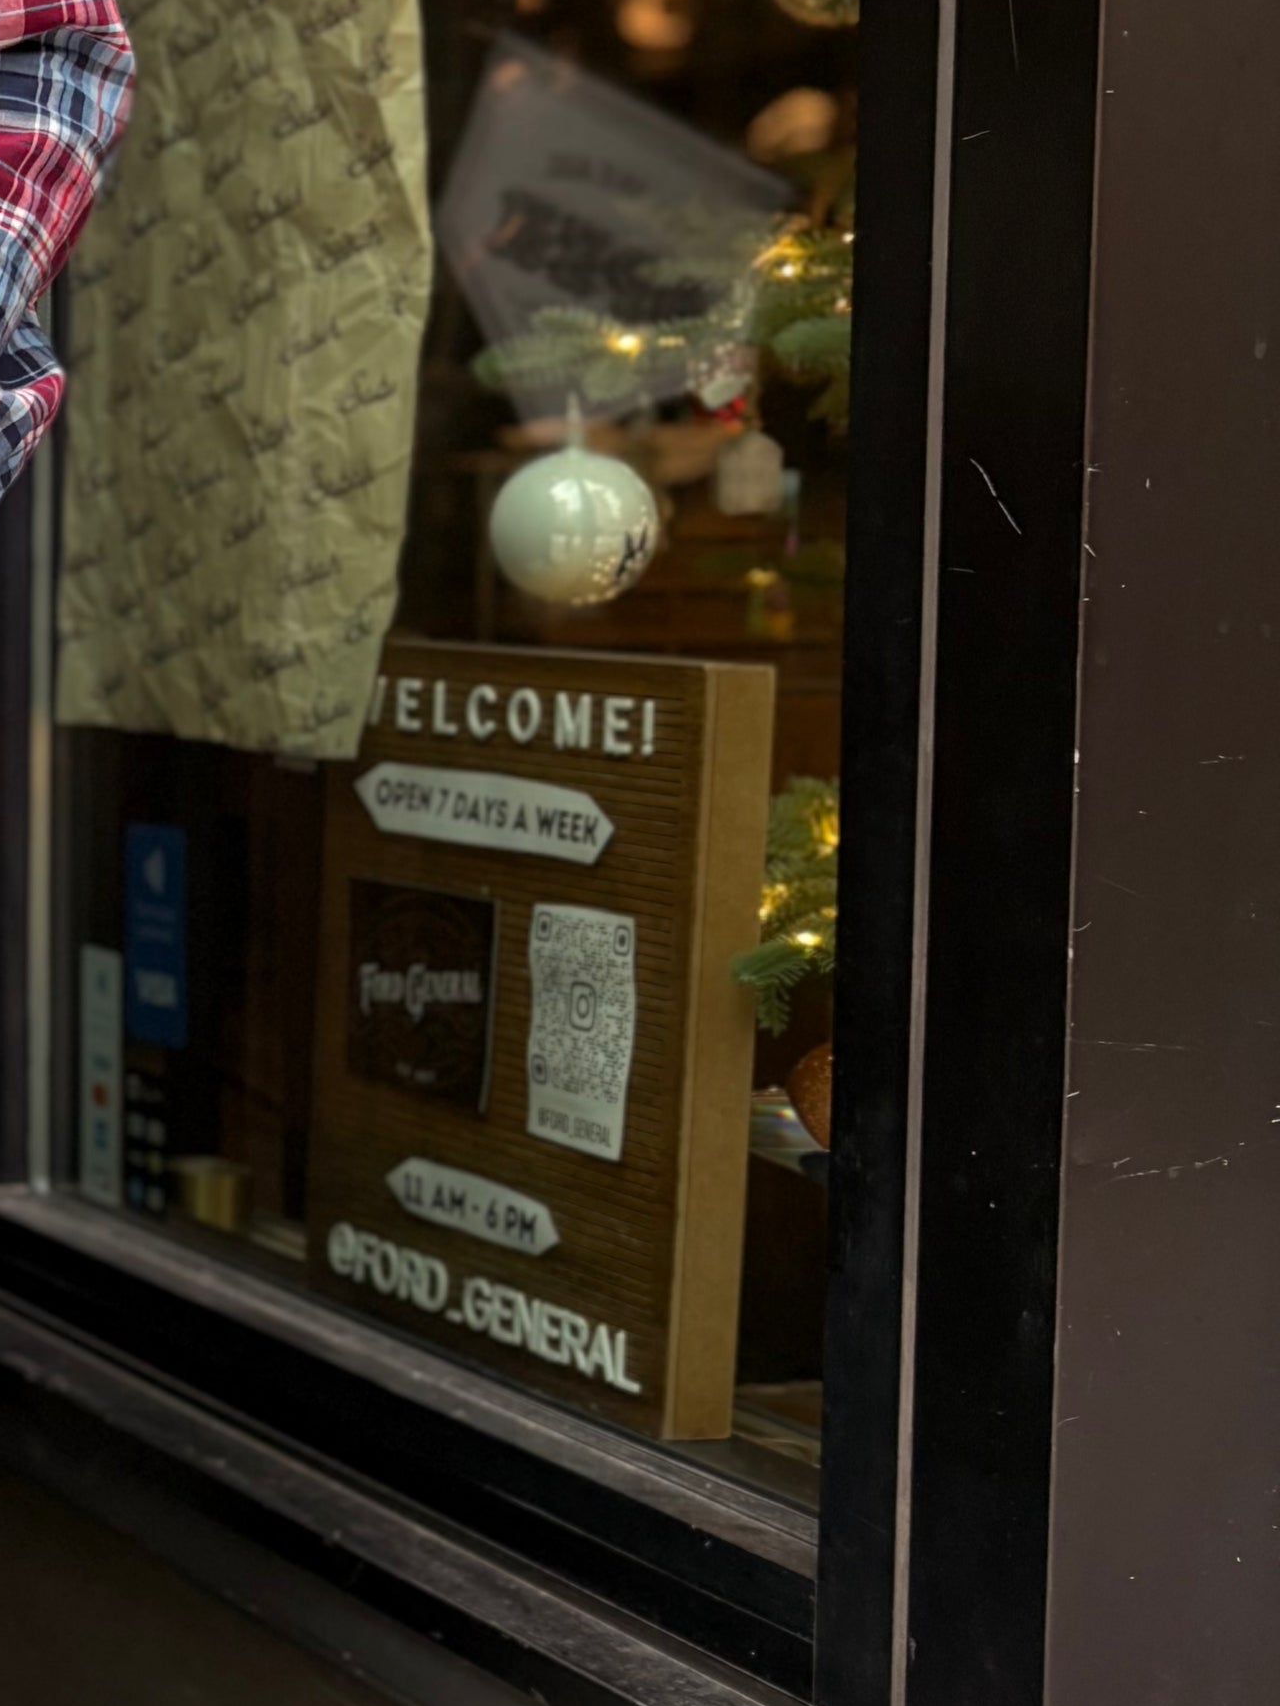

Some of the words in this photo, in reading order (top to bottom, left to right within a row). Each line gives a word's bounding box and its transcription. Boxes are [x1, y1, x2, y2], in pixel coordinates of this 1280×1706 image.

[375, 779, 431, 814] OPEN
[438, 788, 451, 818] 7
[452, 791, 508, 829] DAYS
[511, 803, 529, 834] A
[535, 806, 601, 848] WEEK
[403, 1171, 424, 1206] 11
[430, 1185, 466, 1219] AM
[485, 1200, 498, 1231] 6
[504, 1204, 539, 1245] PM
[327, 1221, 643, 1395] @FORD_GENERAL
